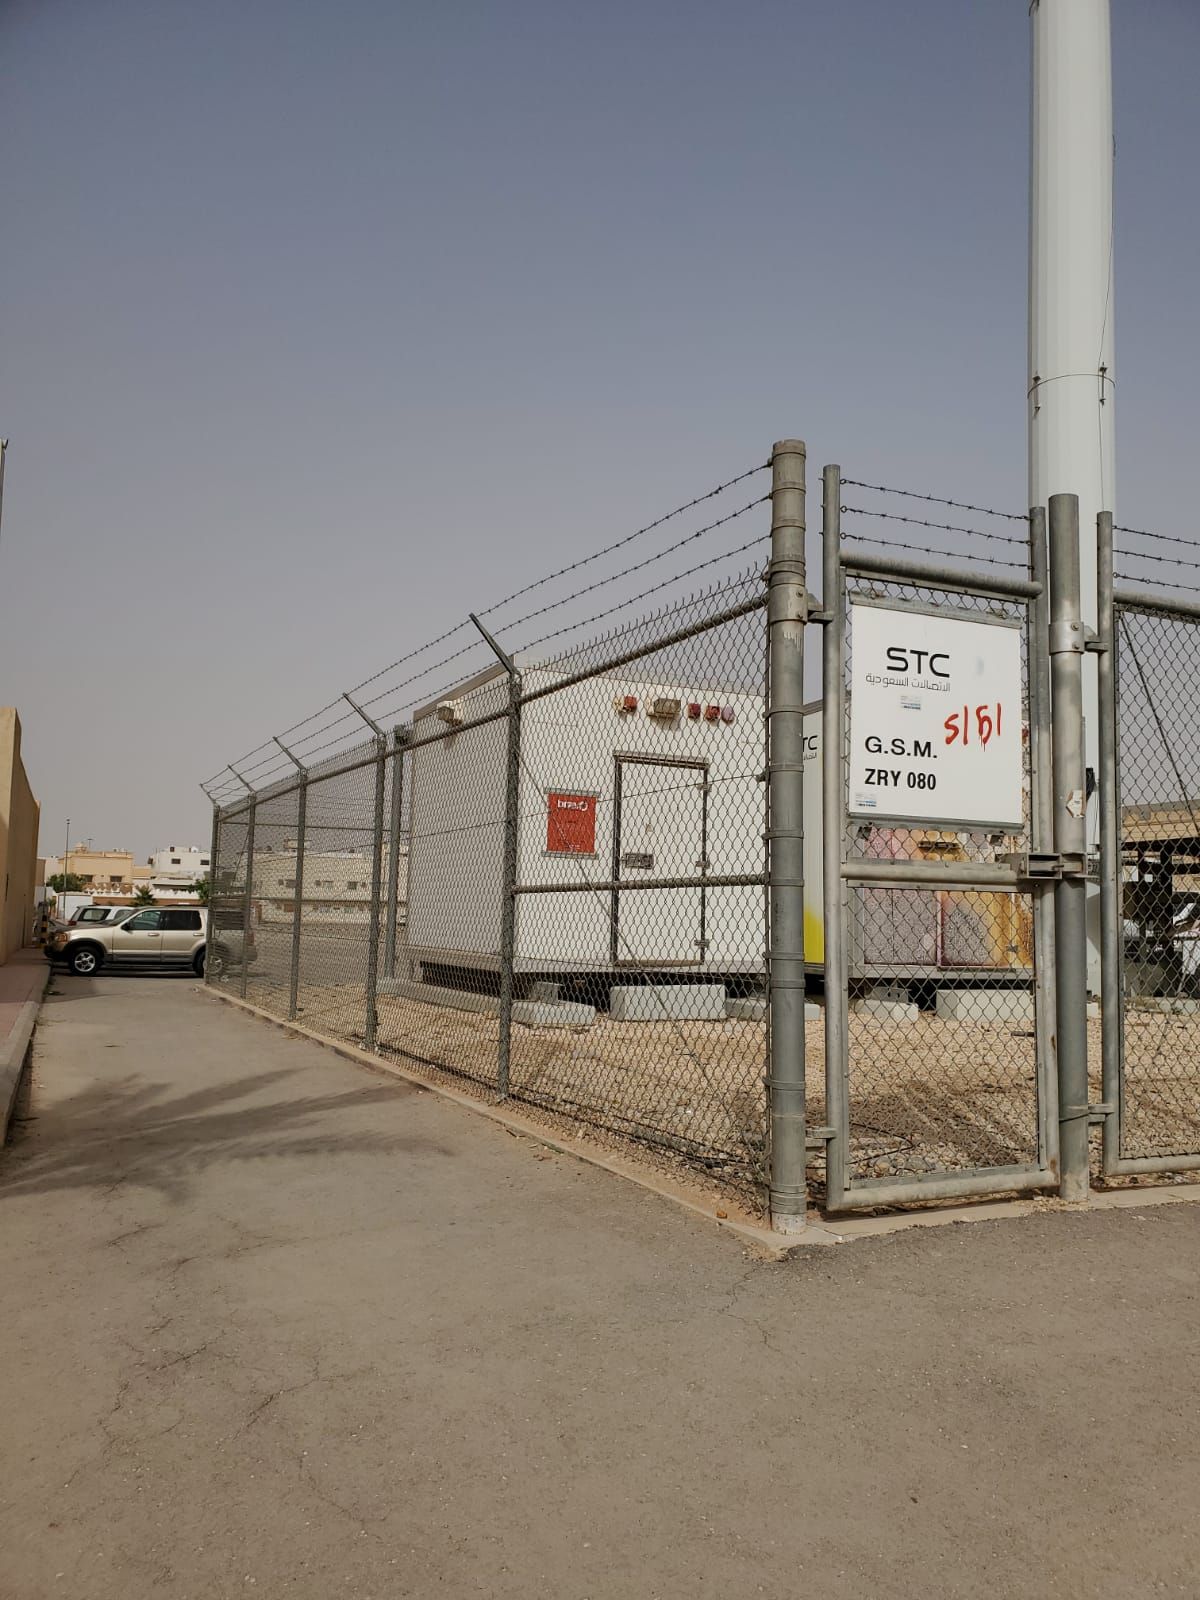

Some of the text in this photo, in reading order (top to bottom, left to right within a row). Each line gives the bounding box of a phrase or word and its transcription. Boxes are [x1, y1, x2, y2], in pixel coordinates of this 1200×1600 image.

[886, 646, 950, 678] STC
[864, 735, 938, 758] G.S.M.
[864, 767, 937, 790] ZRY 080
